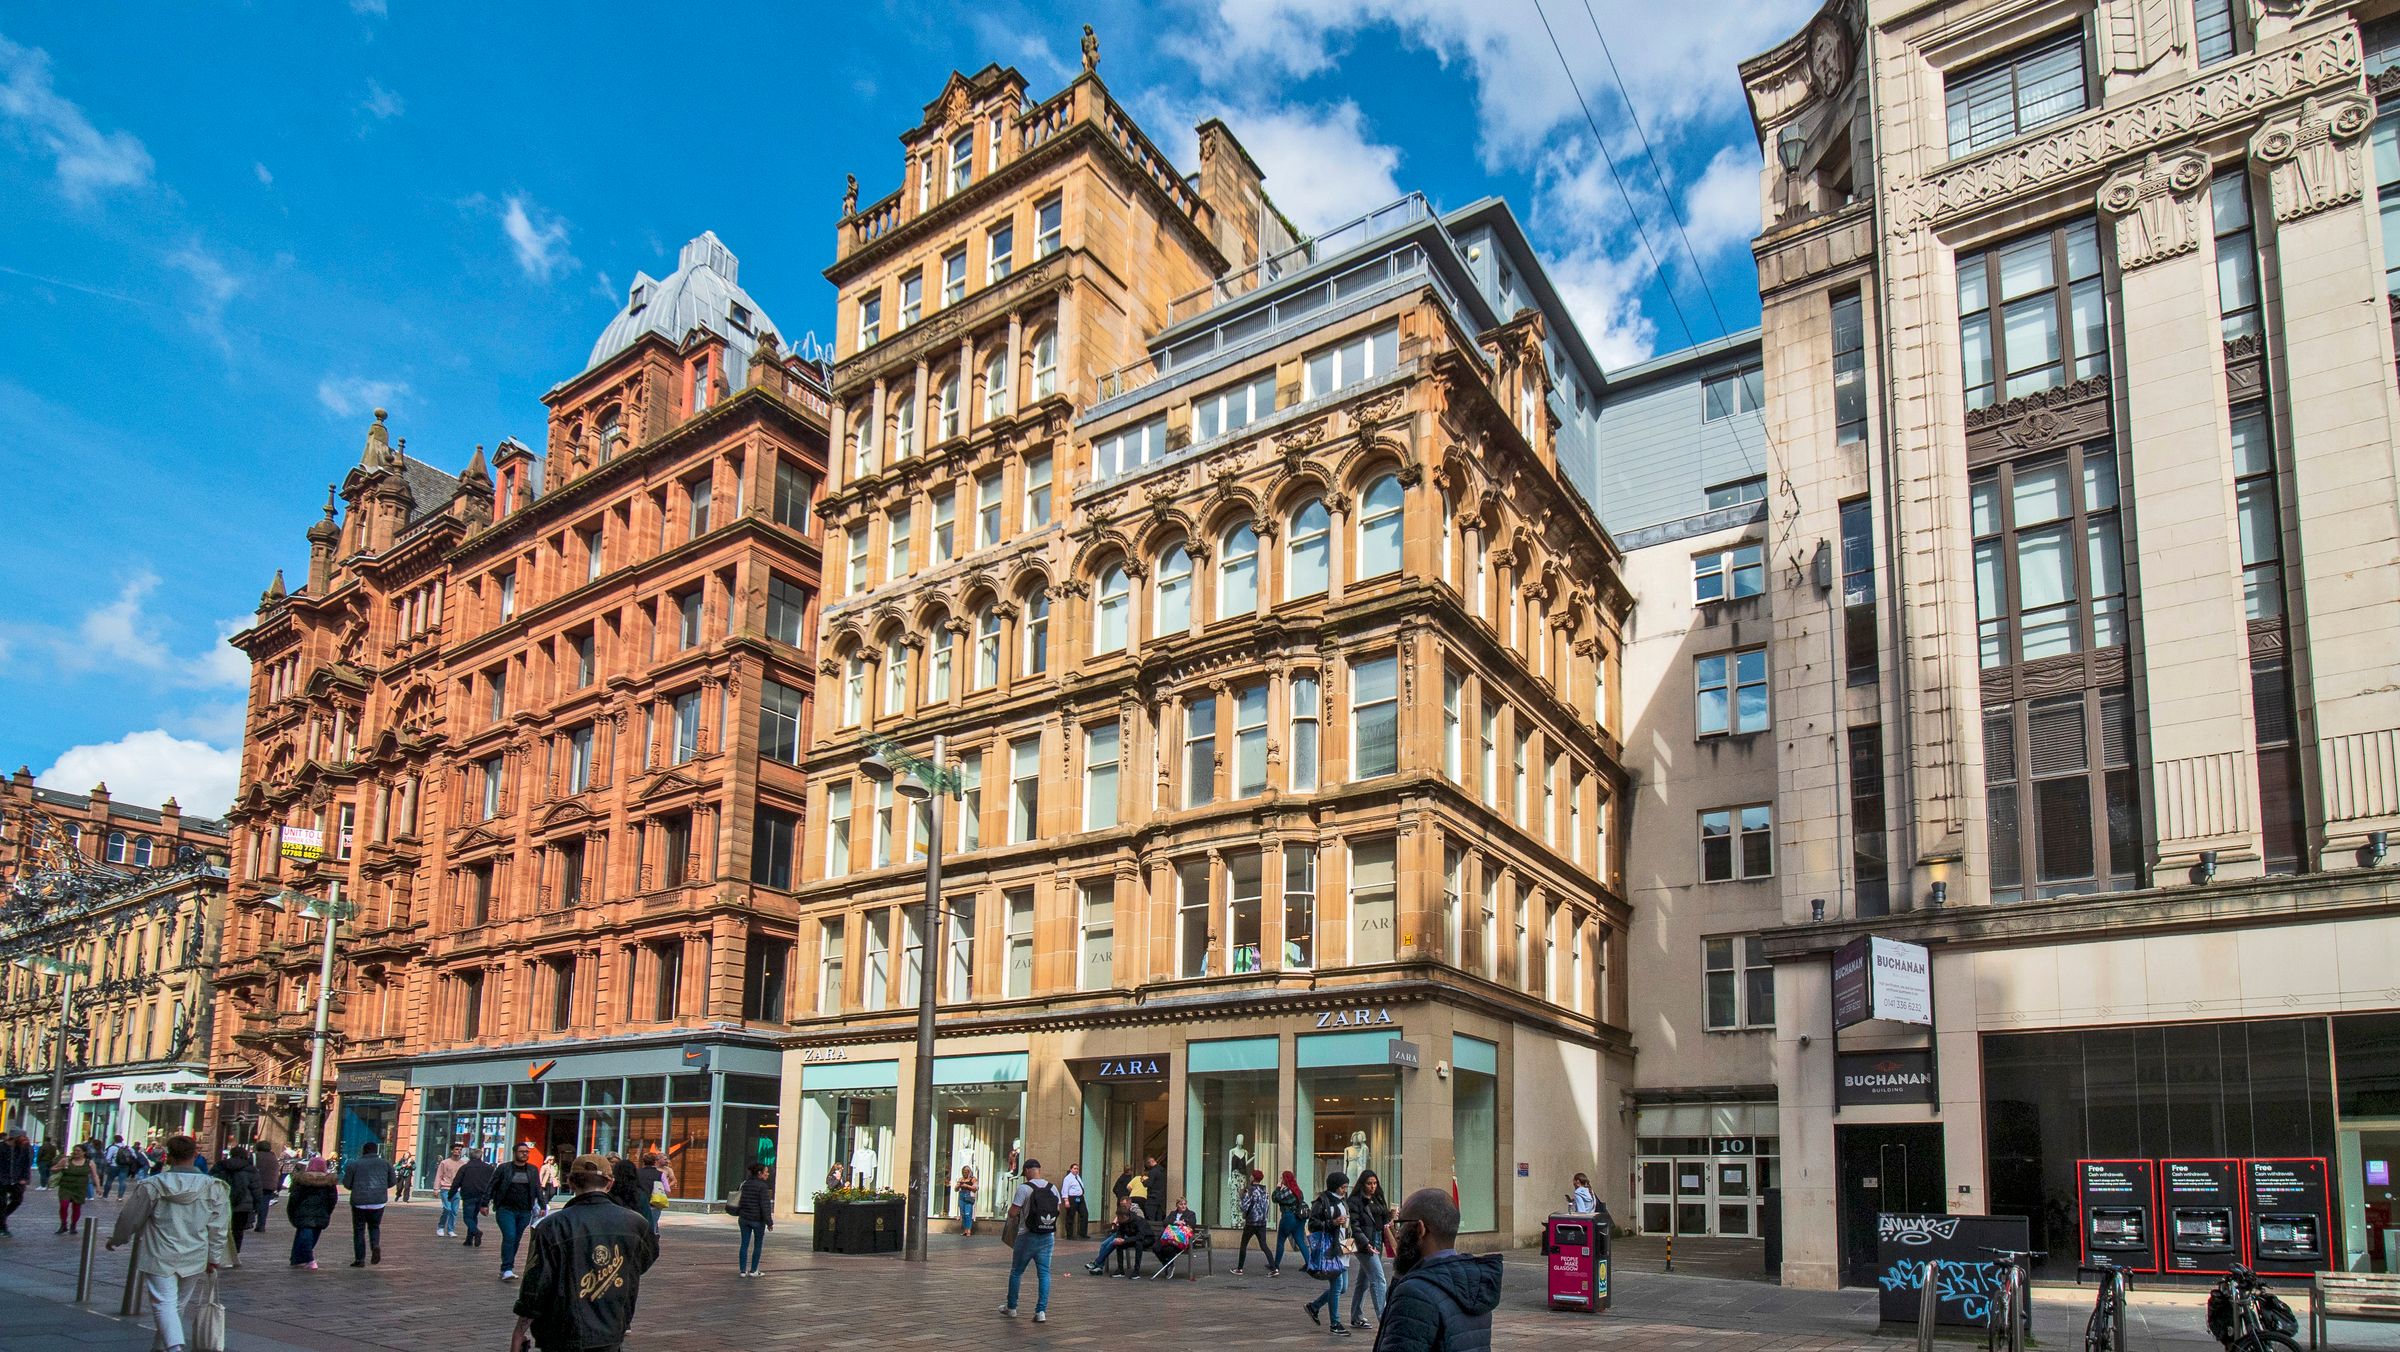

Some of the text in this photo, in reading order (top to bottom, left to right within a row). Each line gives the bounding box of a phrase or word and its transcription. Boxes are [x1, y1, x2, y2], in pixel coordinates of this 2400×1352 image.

[284, 828, 302, 837] UNIT
[305, 830, 314, 838] TO
[1835, 956, 1864, 980] BUCHANAN
[1877, 954, 1925, 974] BUCHANAN
[1316, 1008, 1394, 1028] ZARA
[804, 1048, 848, 1061] ZARA
[1394, 1050, 1418, 1062] ZARA
[1100, 1060, 1160, 1076] ZARA
[1844, 1072, 1931, 1086] BUCHANAN
[1720, 1140, 1744, 1152] 10
[580, 1244, 623, 1298] Diesel
